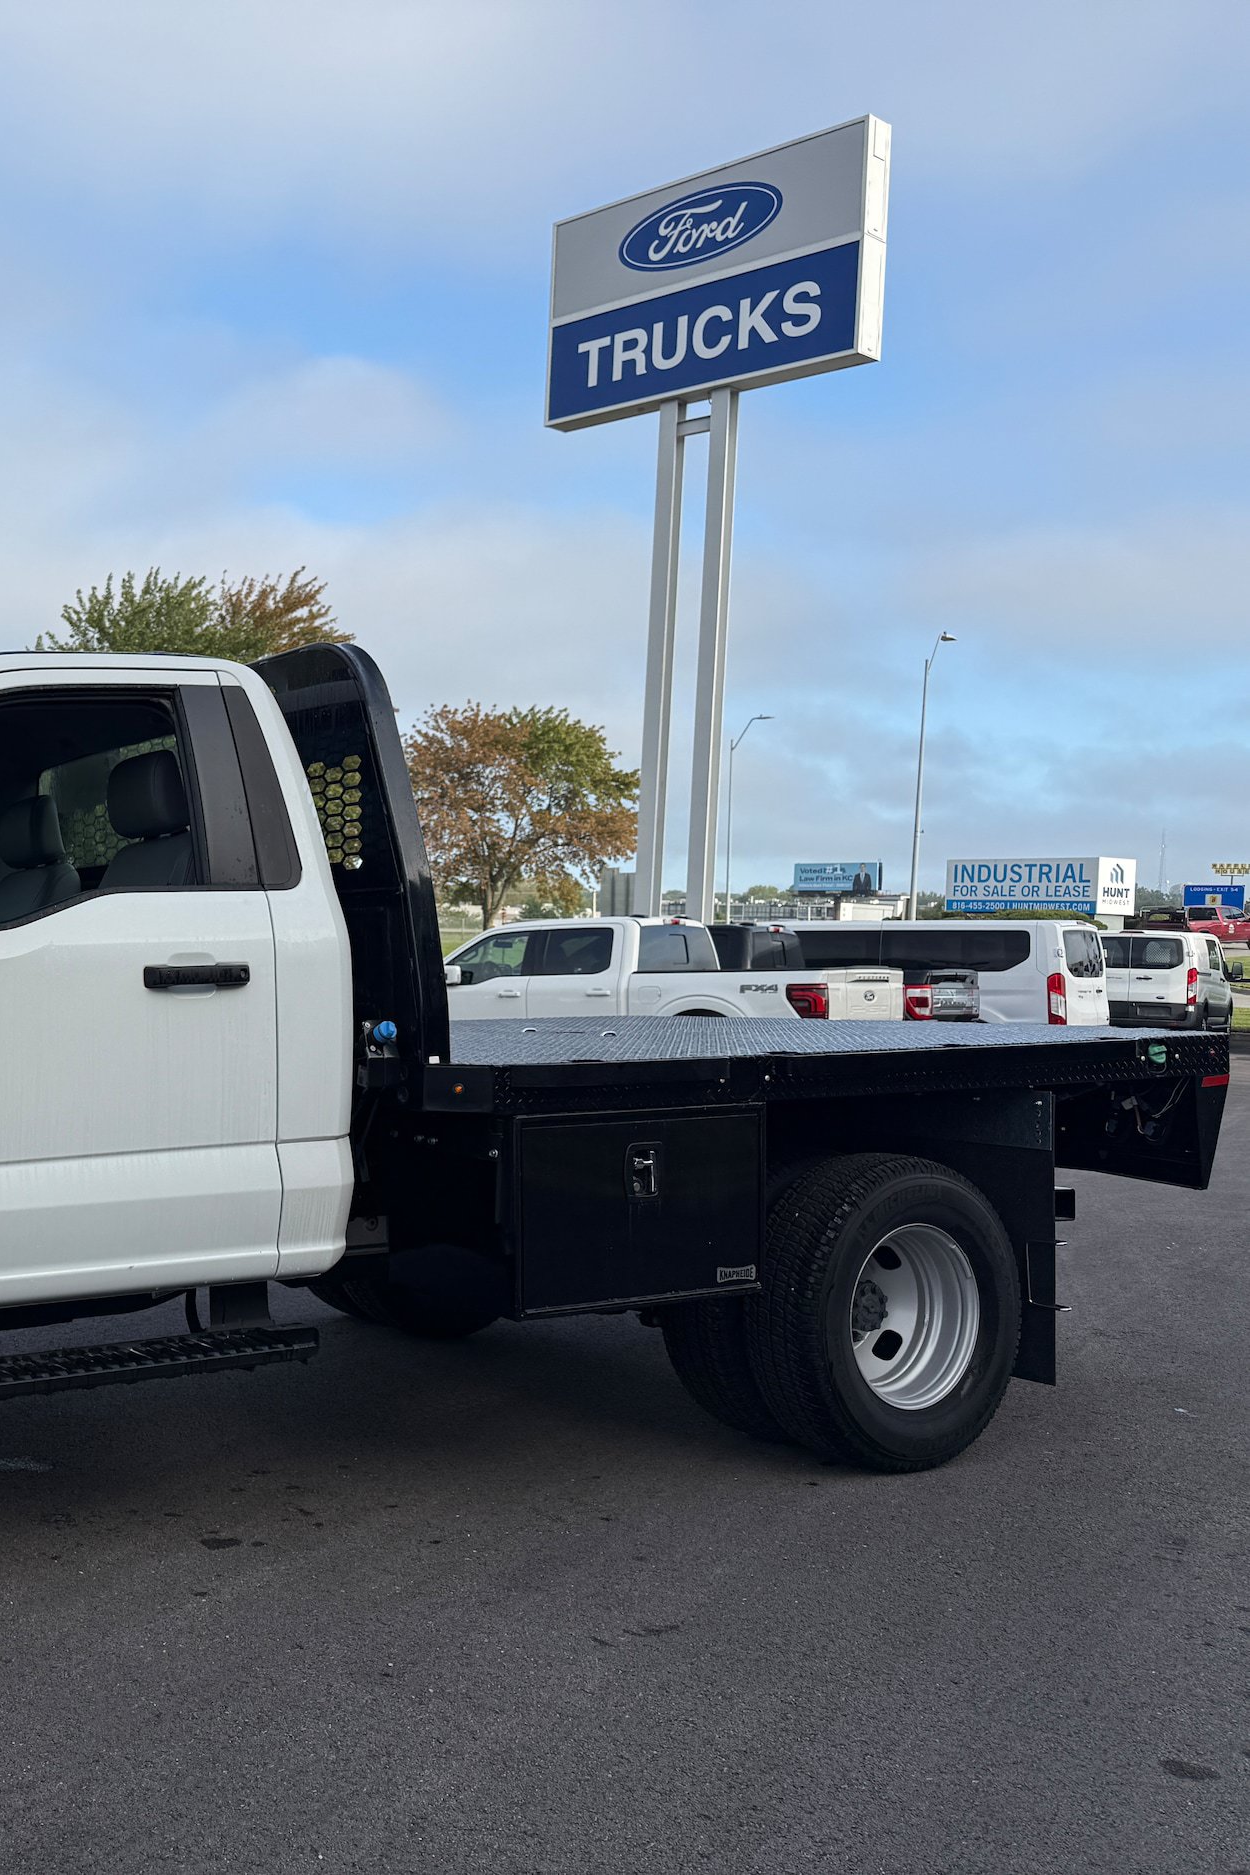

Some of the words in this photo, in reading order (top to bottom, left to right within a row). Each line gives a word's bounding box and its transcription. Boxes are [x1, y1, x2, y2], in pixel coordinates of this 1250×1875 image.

[648, 200, 748, 262] Ford
[577, 281, 822, 388] TRUCKS
[816, 874, 833, 882] Firm
[953, 863, 1091, 884] INDUSTRIAL
[953, 885, 978, 897] FOR
[983, 885, 1016, 897] SALE
[1021, 885, 1040, 897] OR
[1045, 885, 1091, 898] LEASE
[1102, 886, 1131, 899] HUNT
[952, 901, 1005, 910] 816-455-2500
[1012, 902, 1091, 912] HUNTMIDWEST.COM
[739, 984, 778, 994] FX4
